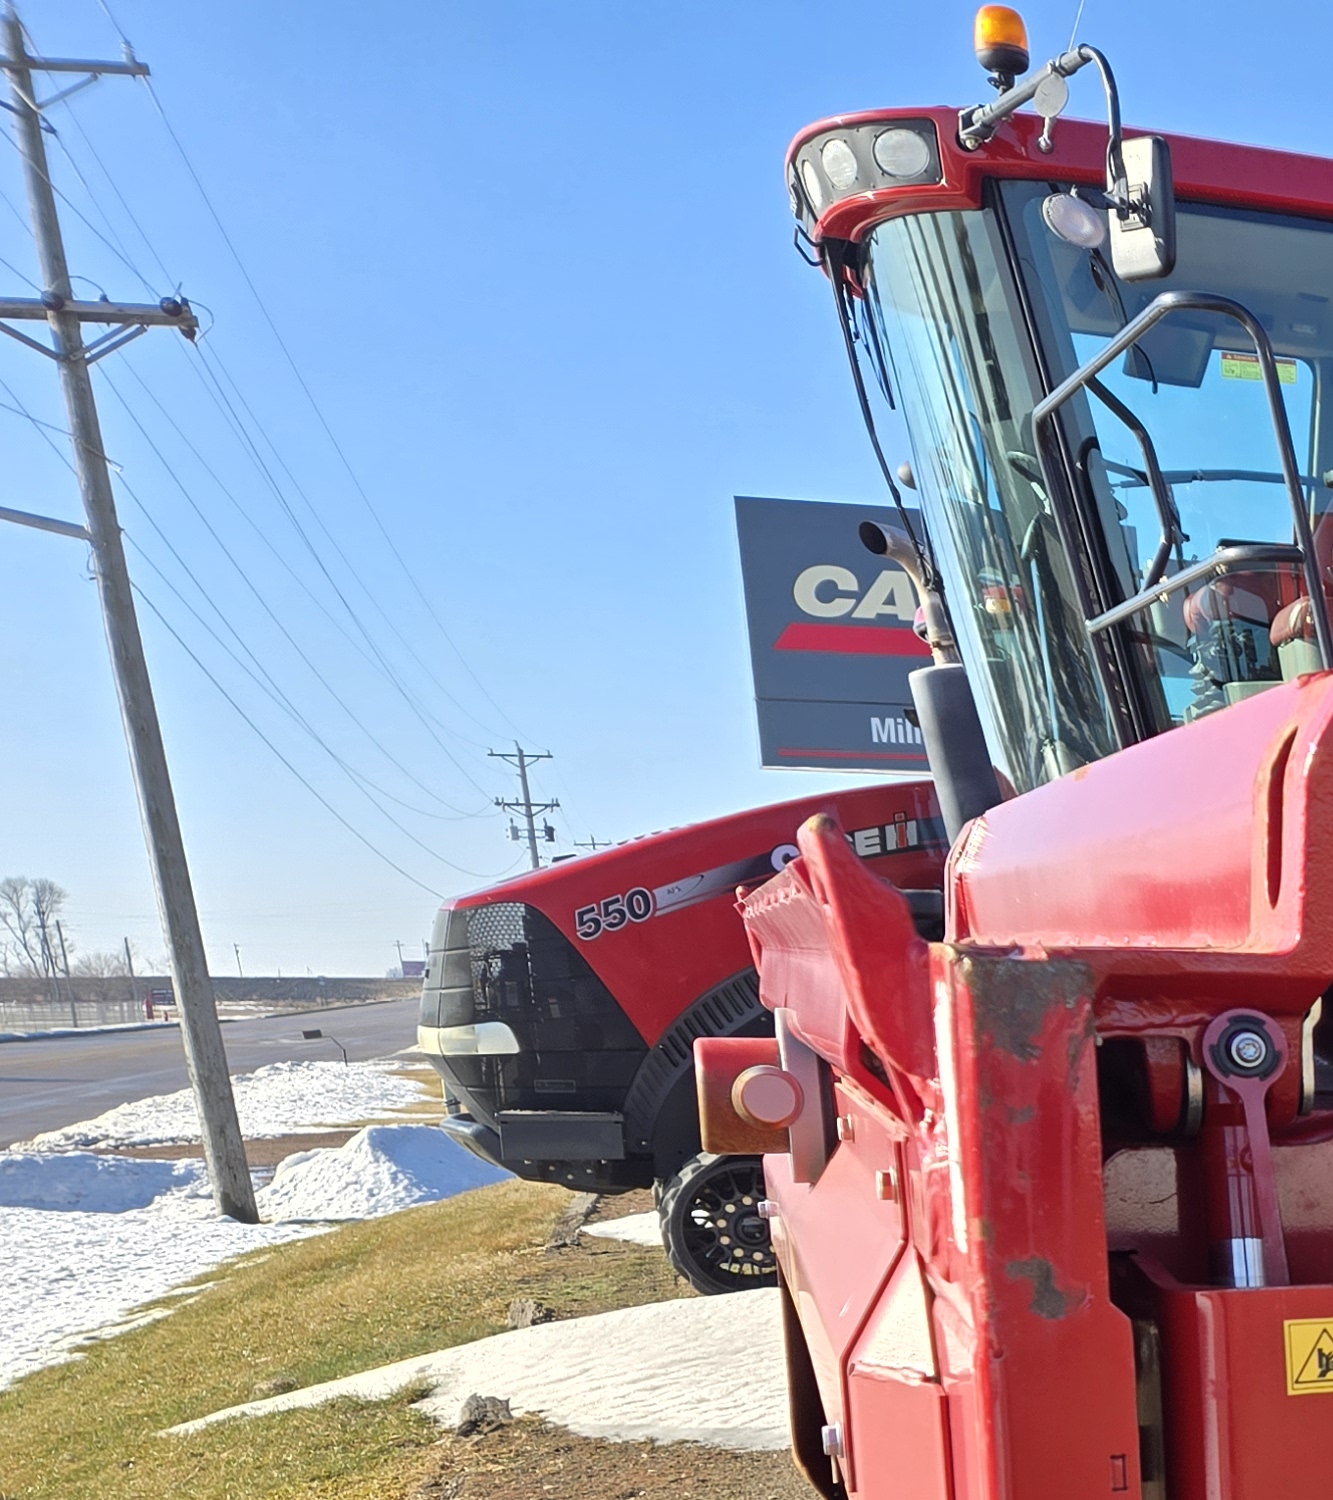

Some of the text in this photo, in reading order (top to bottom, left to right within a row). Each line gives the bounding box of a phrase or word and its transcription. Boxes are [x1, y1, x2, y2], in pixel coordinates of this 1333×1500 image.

[793, 564, 920, 621] CA
[770, 827, 882, 873] CE
[575, 886, 653, 941] 550
